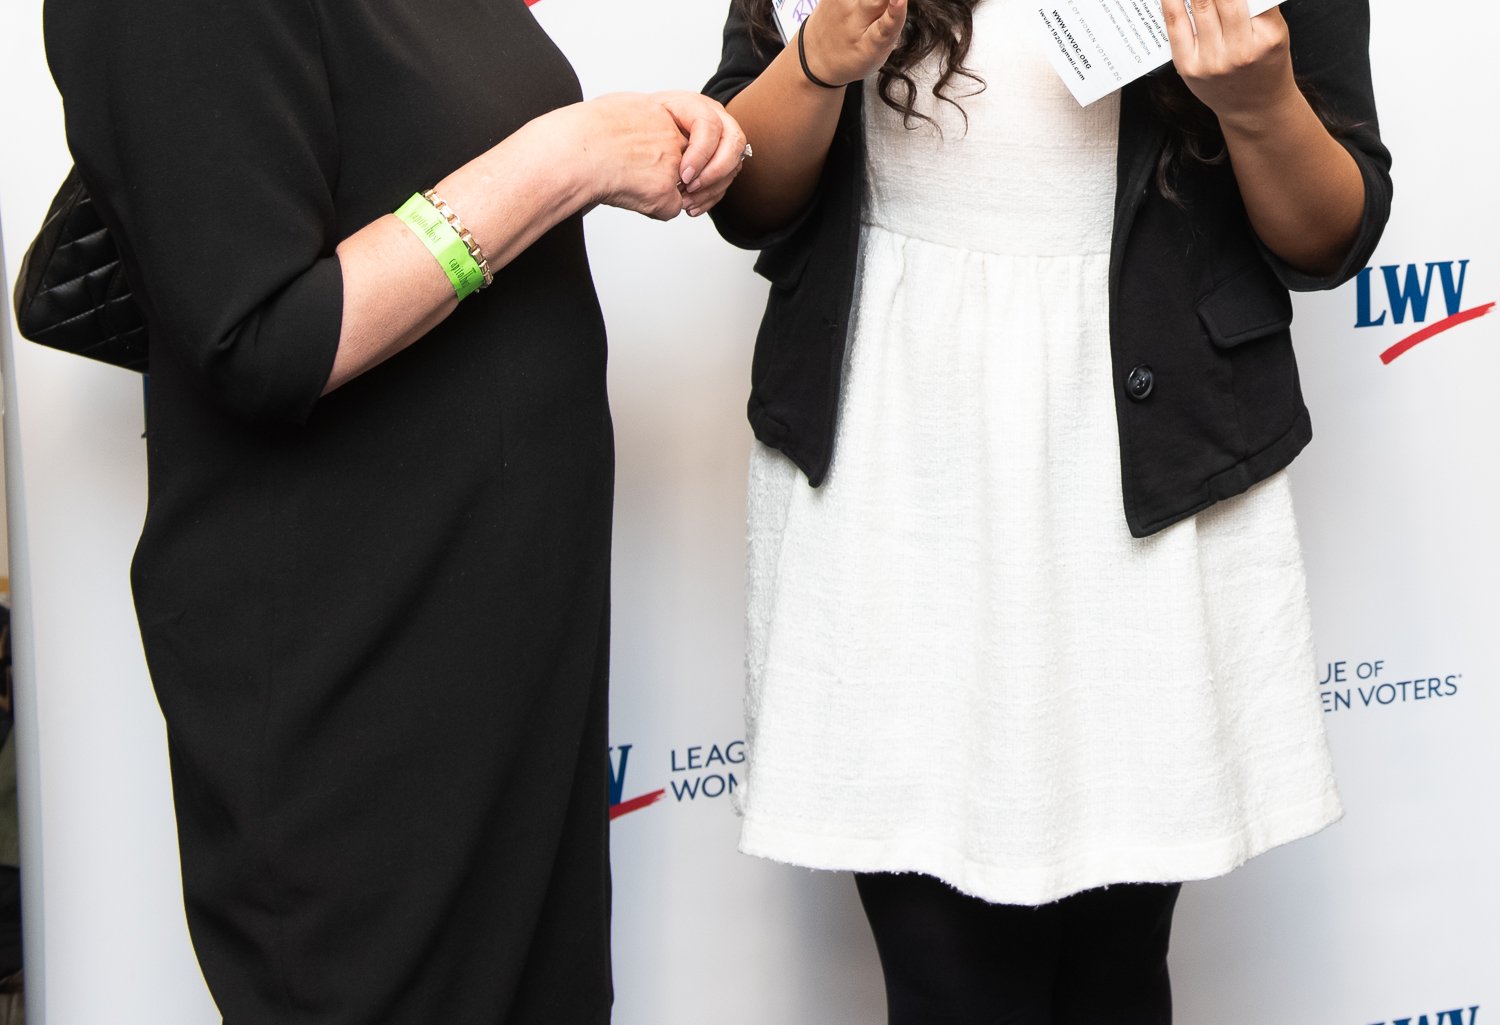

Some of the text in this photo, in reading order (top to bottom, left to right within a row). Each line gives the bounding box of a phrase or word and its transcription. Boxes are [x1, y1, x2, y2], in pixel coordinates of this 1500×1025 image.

[1051, 9, 1092, 69] WWW.LWVDC.ORG
[1130, 0, 1143, 16] make
[1142, 20, 1162, 48] difference
[1141, 2, 1154, 19] heard
[1151, 18, 1161, 30] and
[1157, 29, 1168, 43] your
[1354, 259, 1470, 329] LWV
[1356, 660, 1385, 680] OF
[1358, 674, 1458, 708] VOTERS
[671, 740, 746, 772] LEAG
